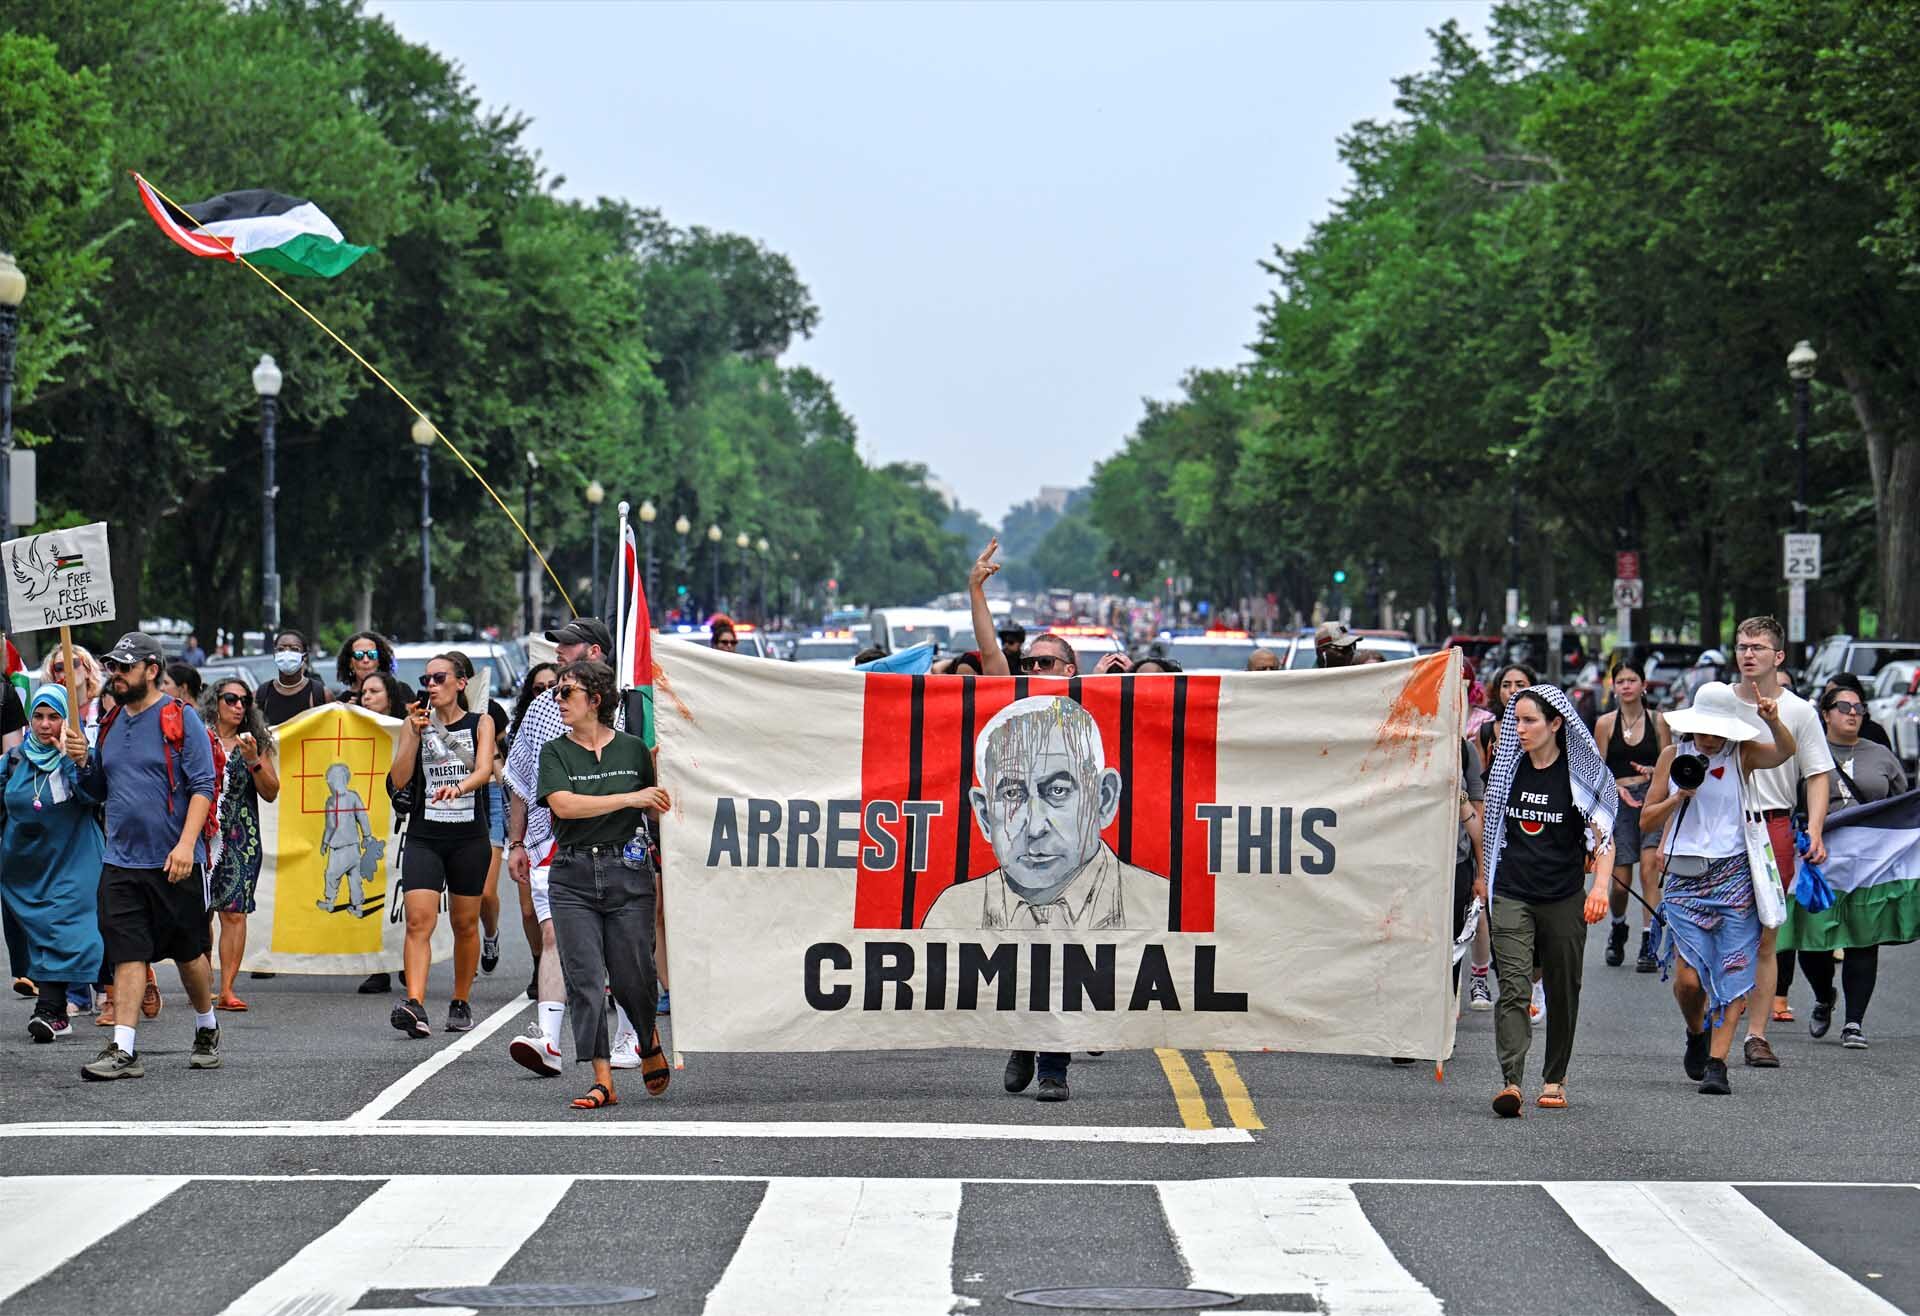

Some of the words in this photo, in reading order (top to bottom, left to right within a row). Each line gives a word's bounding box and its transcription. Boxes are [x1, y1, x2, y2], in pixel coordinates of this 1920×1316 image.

[1789, 558, 1816, 574] 25
[67, 572, 92, 587] FREE
[59, 587, 89, 605] FREE
[44, 600, 109, 625] PALESTINE
[1520, 791, 1549, 805] FREE
[1505, 806, 1564, 823] PALESTINE
[706, 797, 943, 872] ARREST
[1195, 803, 1337, 875] THIS
[803, 941, 1249, 1012] CRIMINAL
